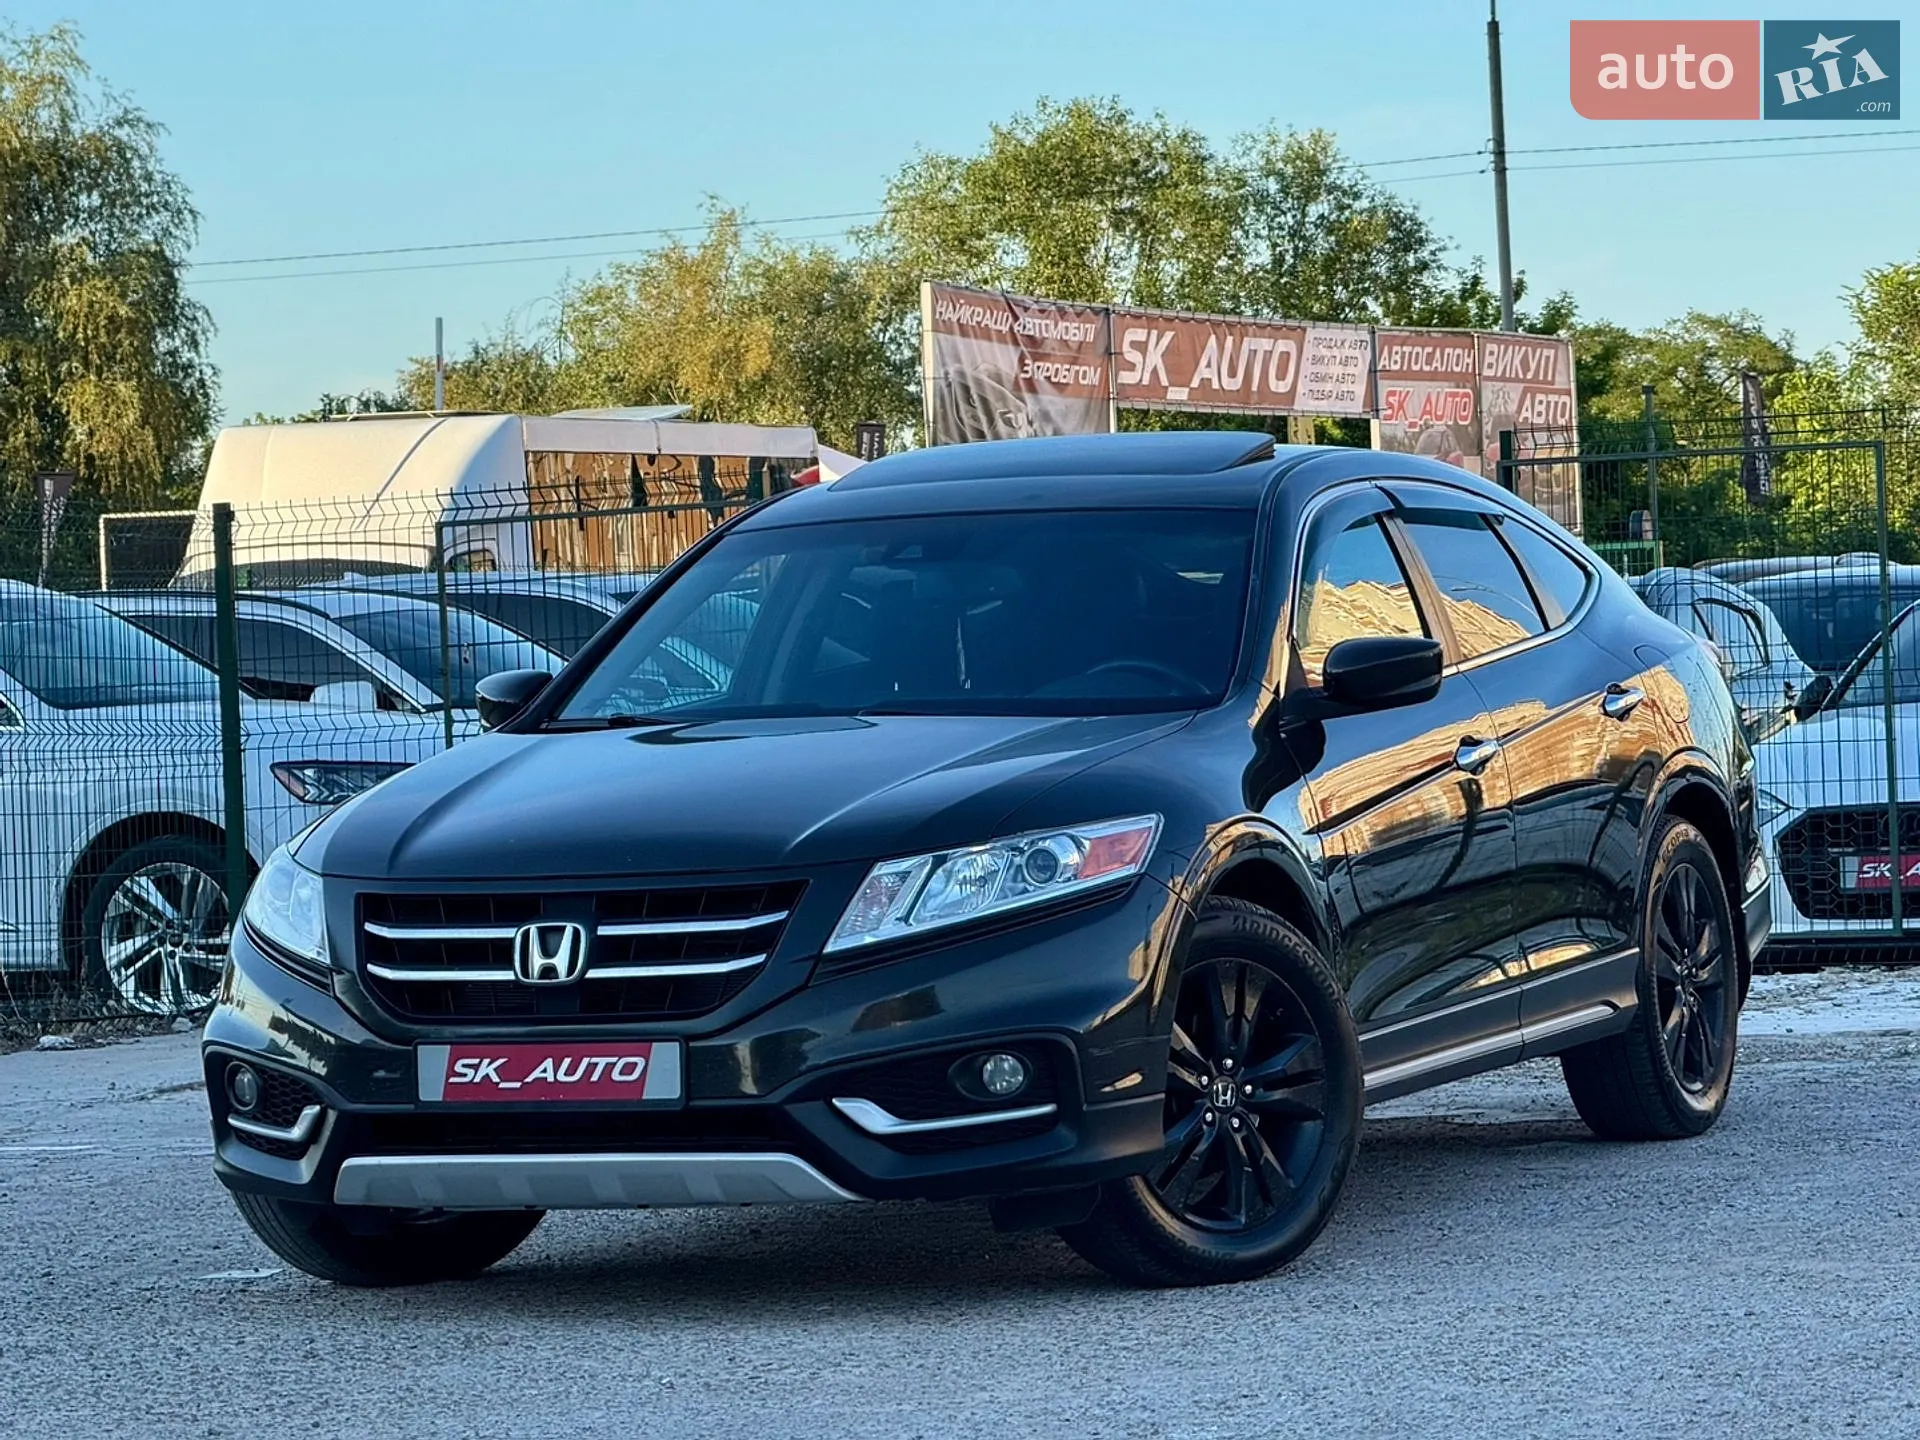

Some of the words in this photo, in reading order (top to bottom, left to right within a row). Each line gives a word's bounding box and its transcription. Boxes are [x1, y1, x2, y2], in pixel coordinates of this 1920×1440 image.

[935, 299, 1011, 334] НАЙКРАЩІ
[1014, 316, 1096, 343] АВТОМОБІЛІ
[1348, 339, 1369, 351] АВТО
[1379, 345, 1474, 373] АВТОСАЛОН
[1020, 359, 1032, 379] З
[1033, 362, 1102, 386] ПРОБІГОМ
[1117, 328, 1297, 400] SK_AUTO
[1311, 354, 1337, 367] ВИКУП
[1338, 355, 1359, 368] АВТО
[1482, 343, 1556, 381] ВИКУП
[1335, 372, 1356, 384] АВТО
[1334, 389, 1356, 402] АВТО
[1382, 387, 1474, 432] SK_AUTO
[1518, 391, 1572, 425] АВТО
[448, 1056, 647, 1089] SK_AUTO
